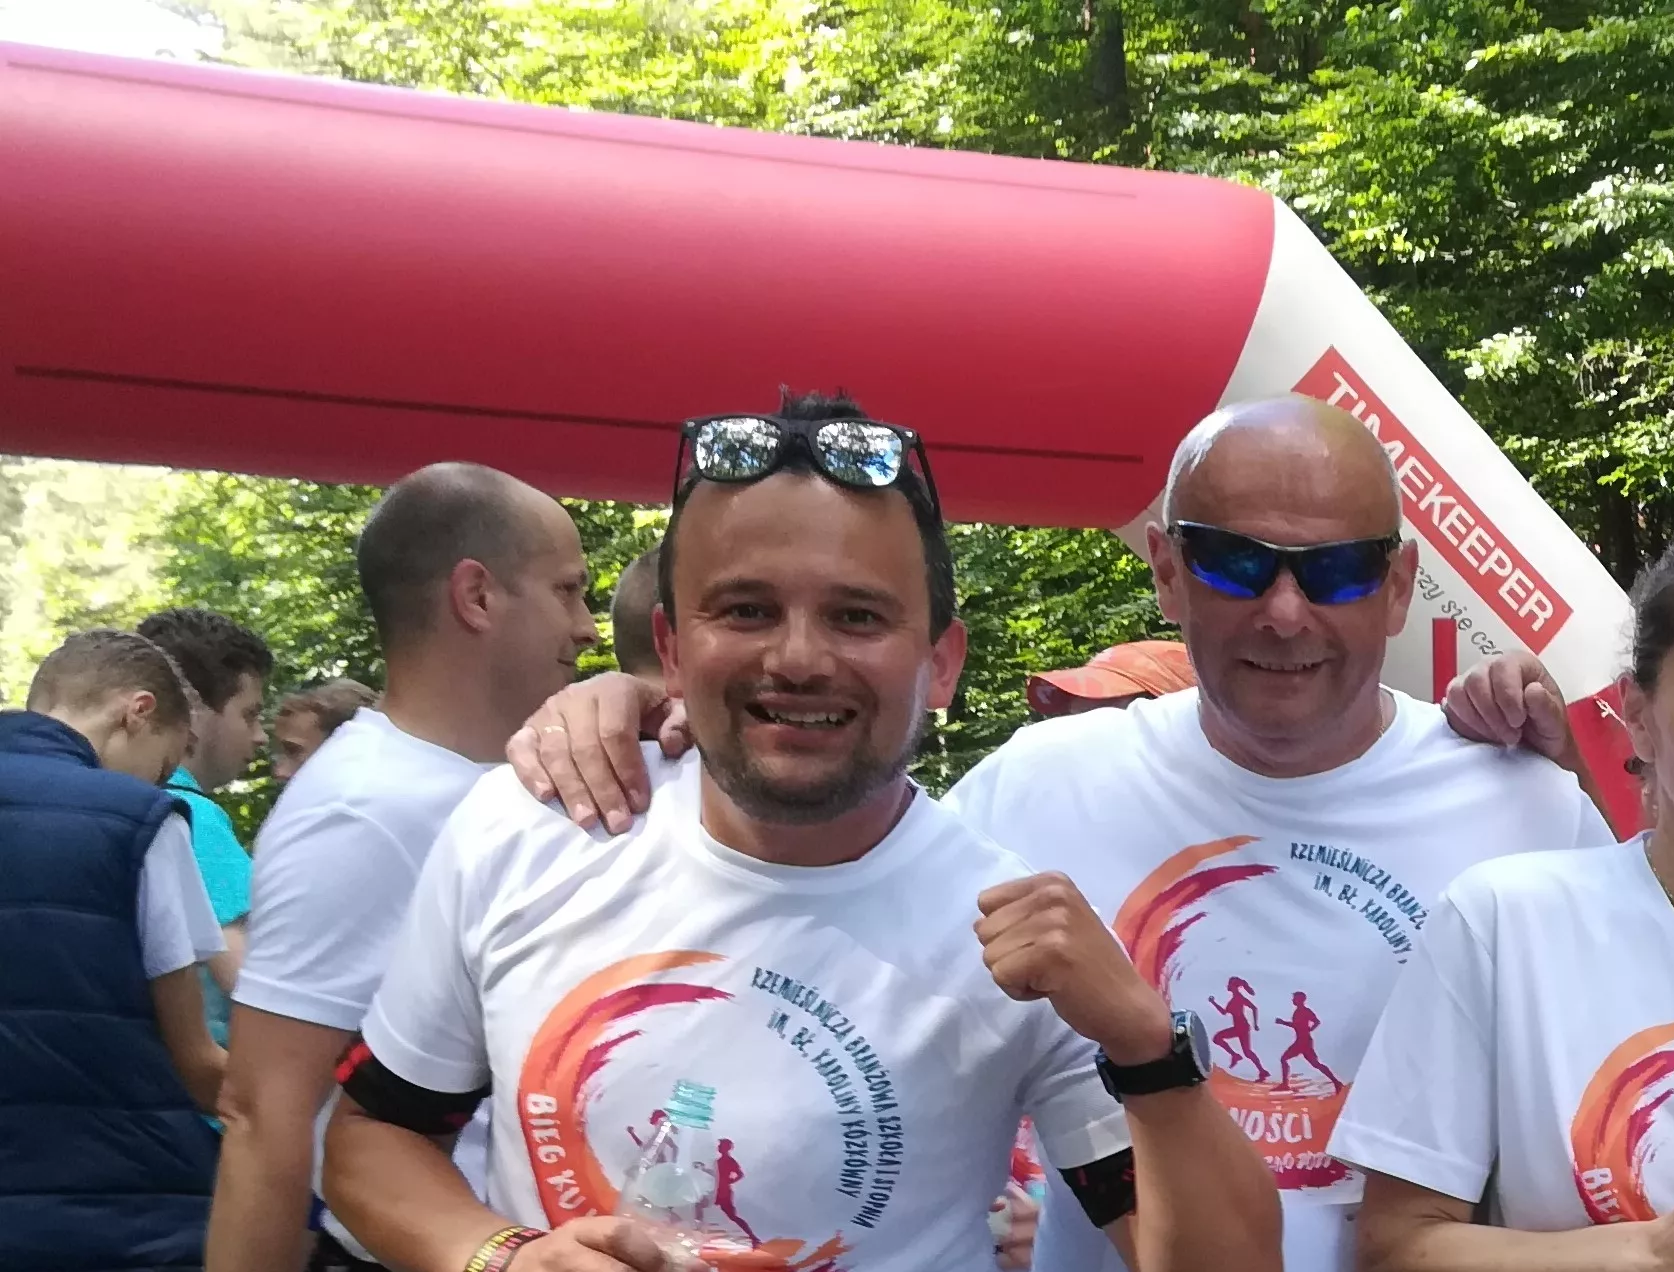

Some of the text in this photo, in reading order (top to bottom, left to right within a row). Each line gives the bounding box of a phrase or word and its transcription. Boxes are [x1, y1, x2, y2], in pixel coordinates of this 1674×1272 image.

[1326, 371, 1555, 633] TIMEKEEPER
[1417, 565, 1445, 600] czy
[1385, 883, 1430, 930] BRANŻ
[1227, 1105, 1313, 1144] NOŚCI
[526, 1092, 587, 1211] BIEG KU
[1582, 1166, 1623, 1222] BIE
